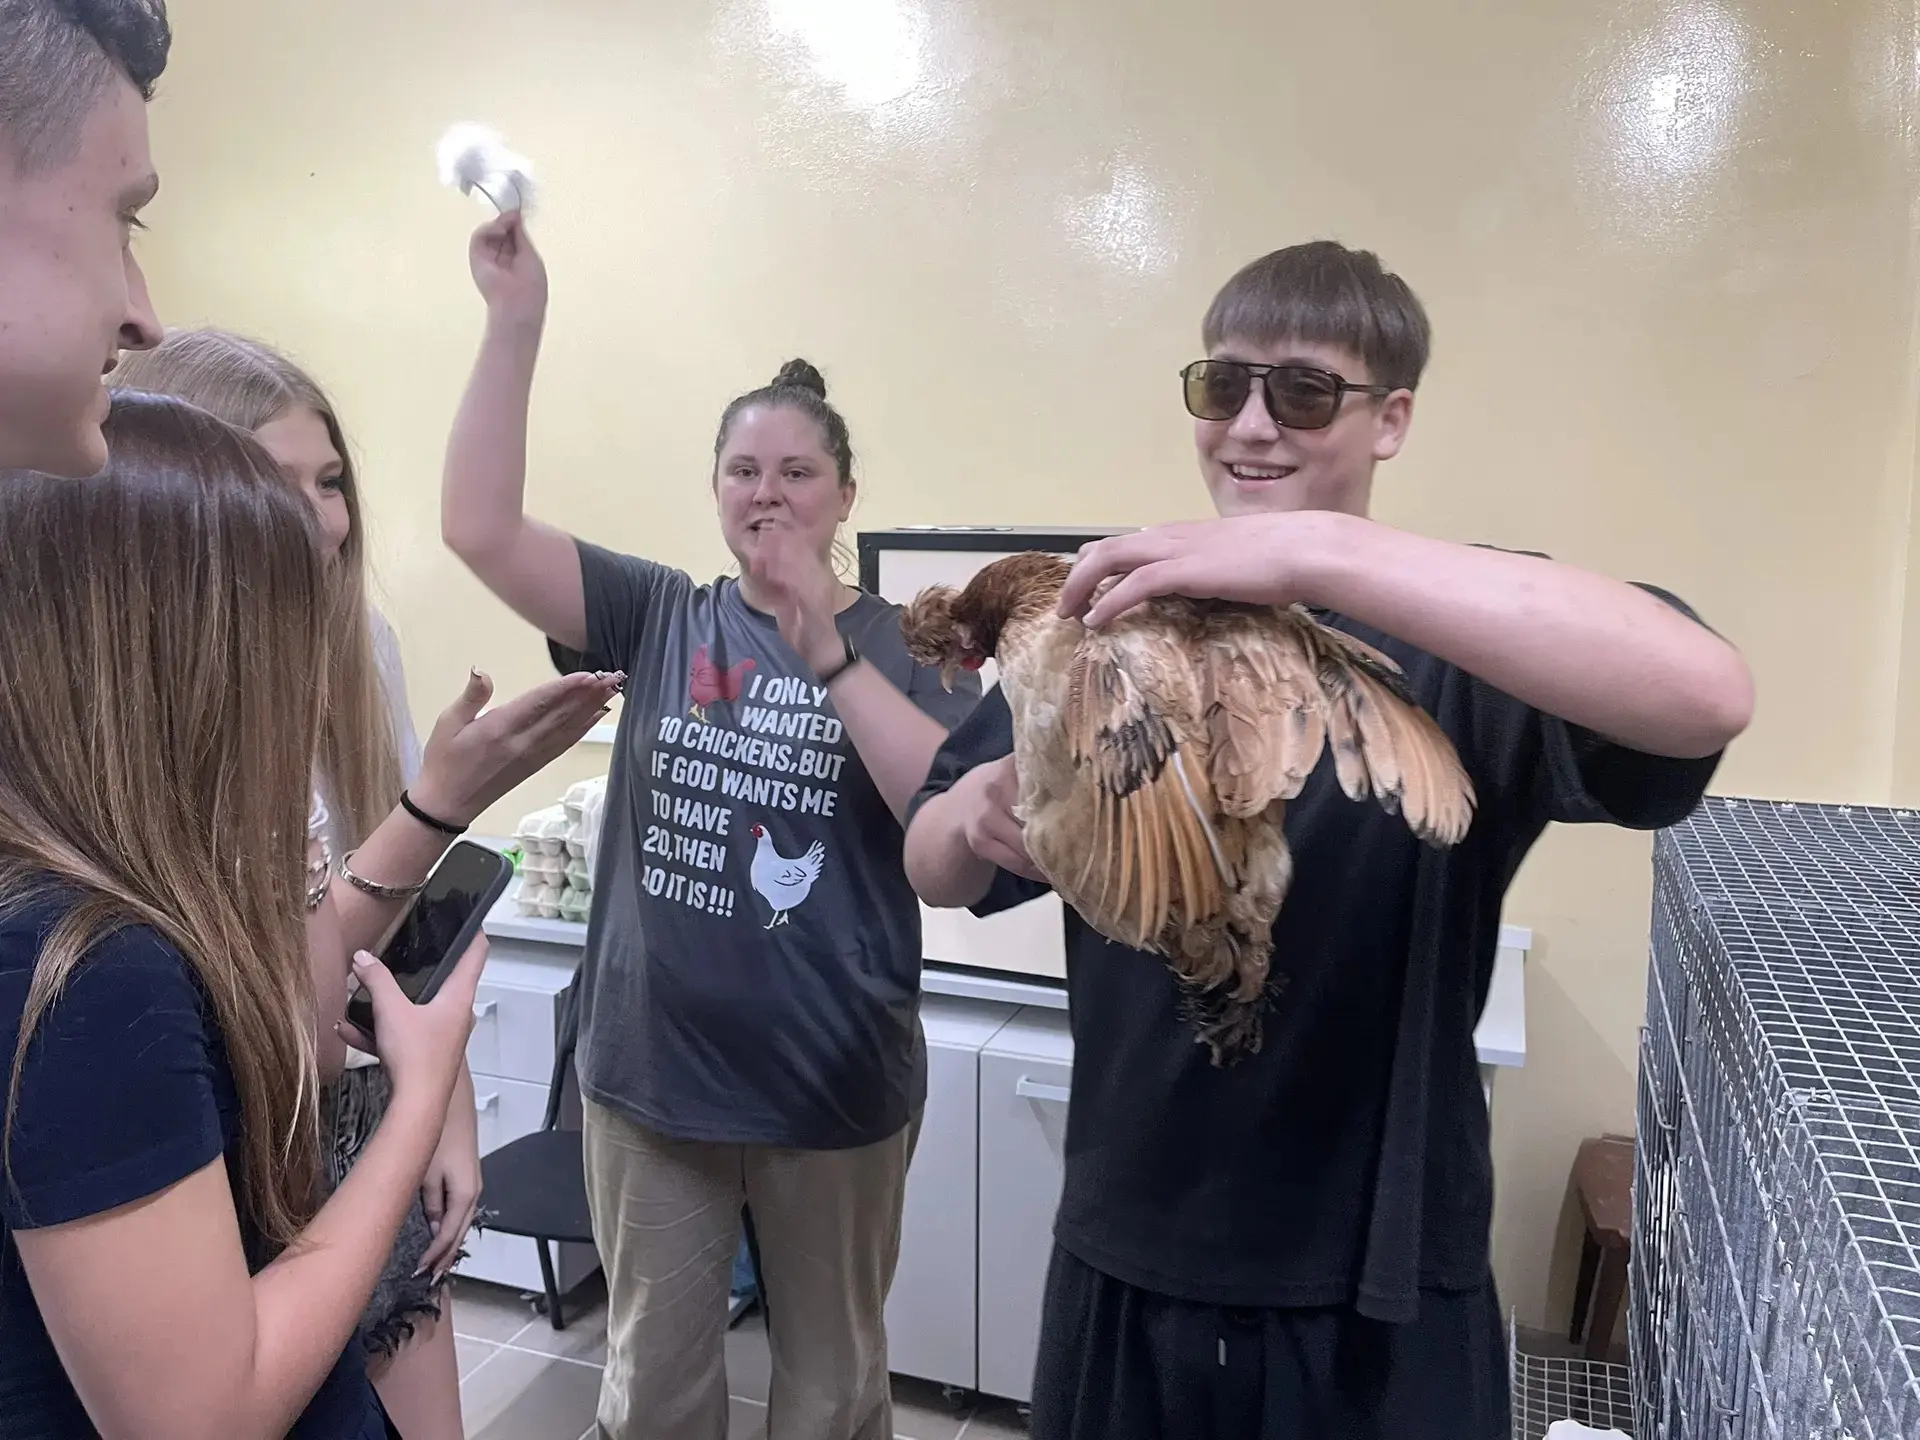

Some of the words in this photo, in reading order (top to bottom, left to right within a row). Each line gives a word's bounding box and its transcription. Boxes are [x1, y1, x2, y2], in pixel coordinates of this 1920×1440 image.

[748, 674, 763, 699] I
[763, 676, 828, 707] ONLY
[657, 715, 683, 744] 10
[740, 706, 842, 744] WANTED
[651, 750, 670, 778] IF
[671, 755, 718, 791] GOD
[721, 767, 799, 811] WANTS
[800, 786, 838, 817] ME
[651, 789, 671, 820] TO
[673, 797, 732, 836] HAVE
[665, 872, 687, 902] IT
